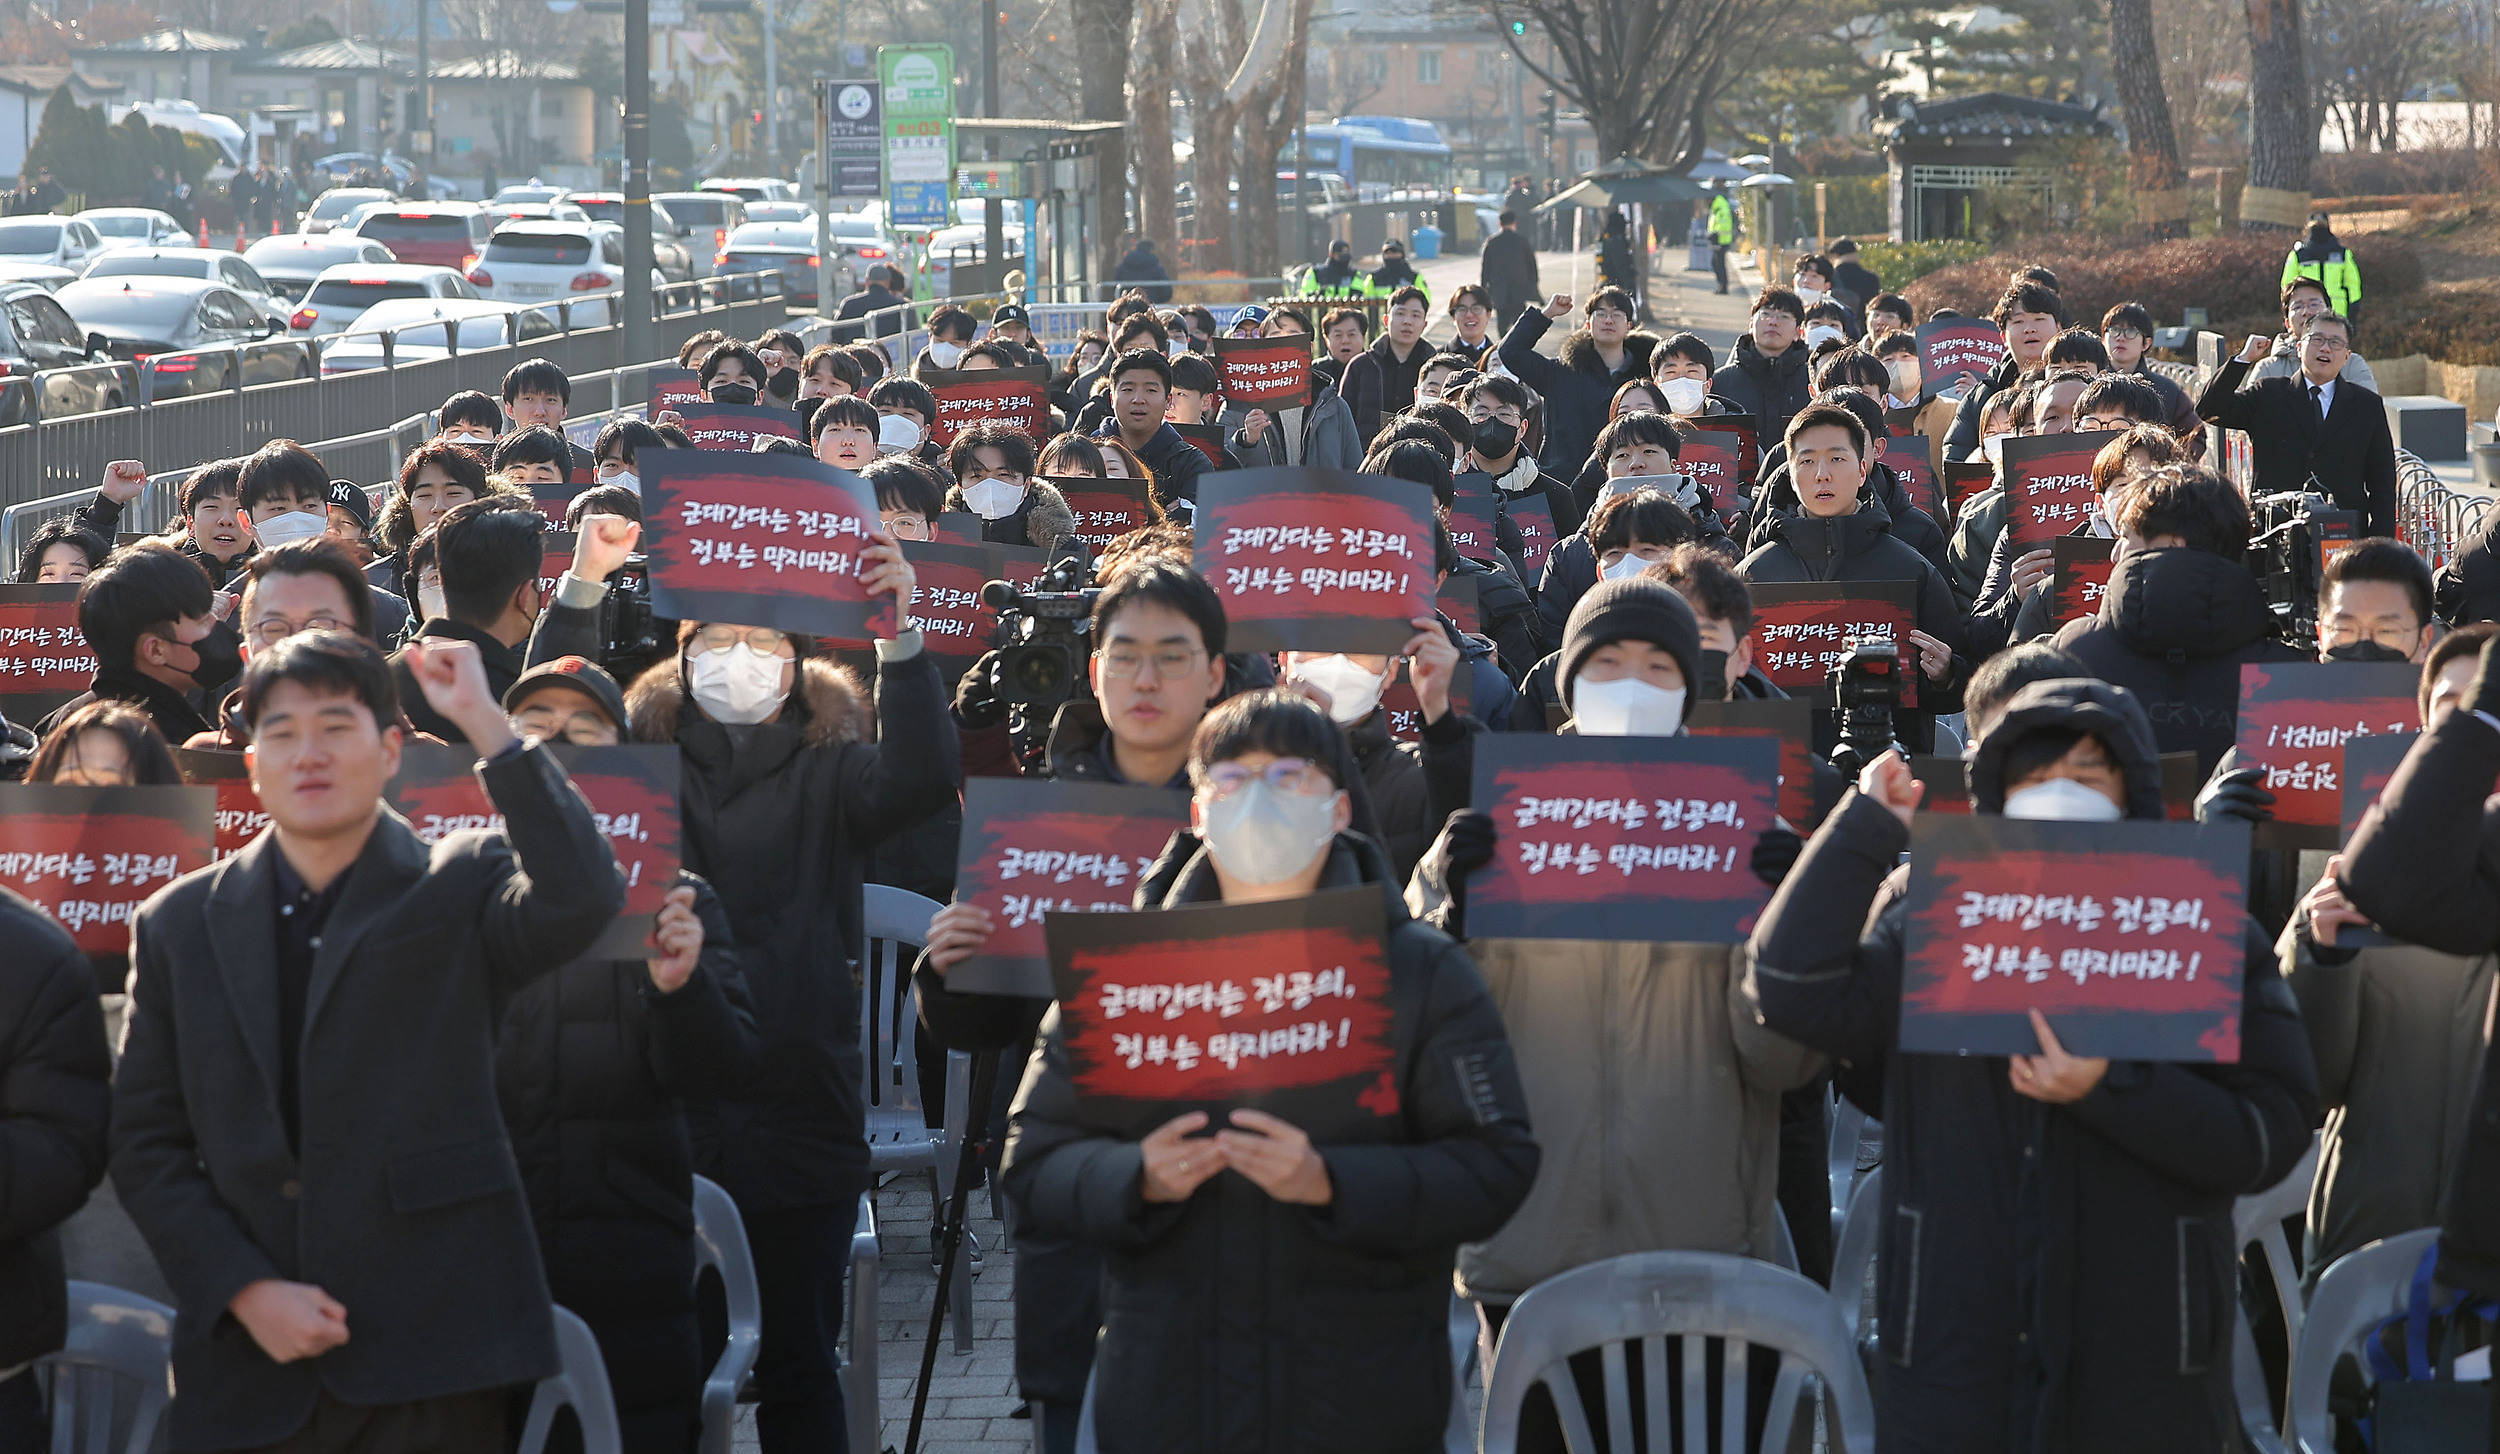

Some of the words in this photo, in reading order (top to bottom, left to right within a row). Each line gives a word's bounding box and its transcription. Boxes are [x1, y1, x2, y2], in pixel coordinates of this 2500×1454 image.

[1930, 337, 1975, 355] 군대간다는
[1226, 361, 1268, 375] 군대간다는
[1269, 359, 1302, 374] 전공의,
[1933, 354, 1960, 370] 정부는
[1961, 352, 2000, 367] 막지마라
[1230, 378, 1254, 392] 정부는
[1255, 375, 1299, 392] 막지마라!
[662, 391, 701, 405] 군대간다
[939, 397, 995, 413] 군대간다는
[997, 396, 1035, 411] 전공의,
[692, 430, 750, 443] 군대간다는
[1685, 461, 1725, 476] 전공의,
[681, 500, 792, 534] 군대간다는
[795, 509, 869, 541] 전공의,
[1088, 511, 1132, 527] 전공의,
[2031, 502, 2078, 523] 정부는
[1223, 525, 1335, 556] 군대간다는
[1340, 527, 1414, 560] 전공의,
[1450, 531, 1479, 547] 공의,
[688, 538, 758, 570] 정부는
[762, 545, 863, 578] 막지마라!
[1226, 566, 1295, 596] 정부는
[929, 586, 981, 611] 전공의,
[0, 626, 52, 647] 간다는
[1762, 623, 1840, 643] 군대간다는
[0, 656, 27, 676] 부는
[31, 656, 98, 676] 막지마라
[1766, 651, 1815, 671] 정부는
[1514, 797, 1649, 830] 군대간다는
[1654, 798, 1745, 832] 전공의,
[998, 847, 1131, 887] 군대간다는
[1519, 840, 1602, 875] 정부는
[0, 852, 96, 886] 대간다는
[1956, 891, 2105, 932] 군대간다는
[2112, 895, 2211, 936] 전공의,
[1961, 943, 2054, 982] 정부는
[1098, 980, 1247, 1020] 군대간다는
[1251, 966, 1356, 1014] 전공의,
[1112, 1033, 1202, 1071] 정부는
